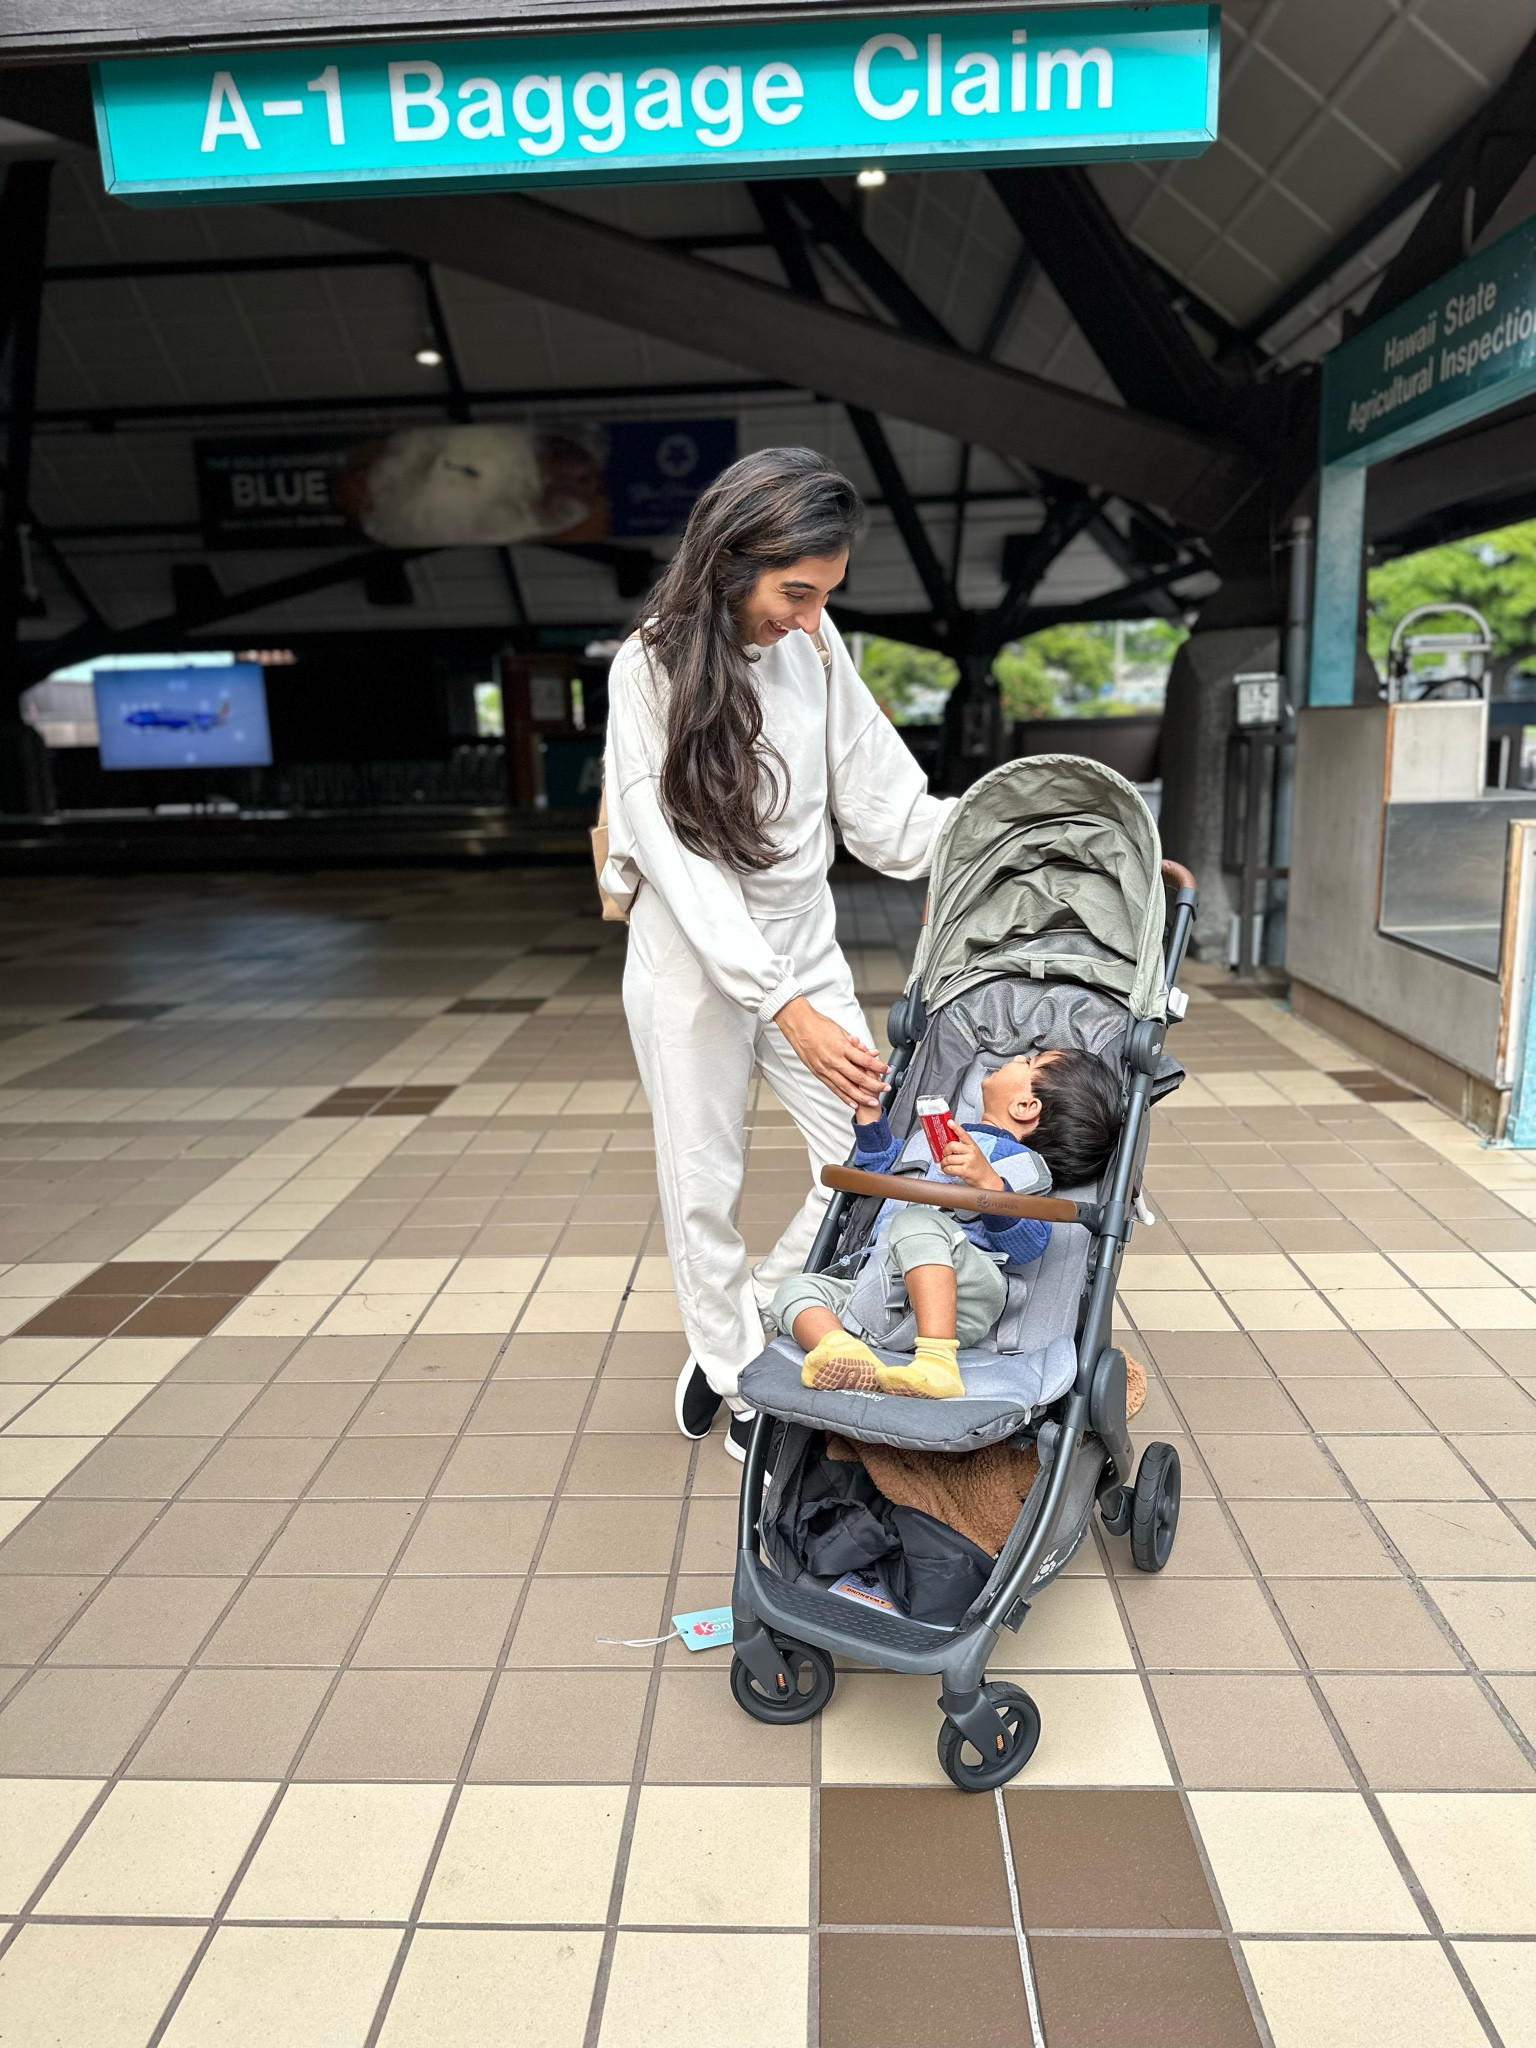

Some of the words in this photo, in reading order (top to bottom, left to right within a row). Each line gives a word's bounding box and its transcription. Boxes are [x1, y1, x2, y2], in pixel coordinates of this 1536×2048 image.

[200, 65, 346, 153] A-1
[387, 60, 805, 156] Baggage
[853, 29, 1114, 121] Claim
[1384, 310, 1437, 372] Hawaii
[1444, 282, 1497, 336] State
[1348, 355, 1434, 433] Agricultural
[232, 470, 330, 507] BLUE
[698, 1621, 734, 1634] Kon
